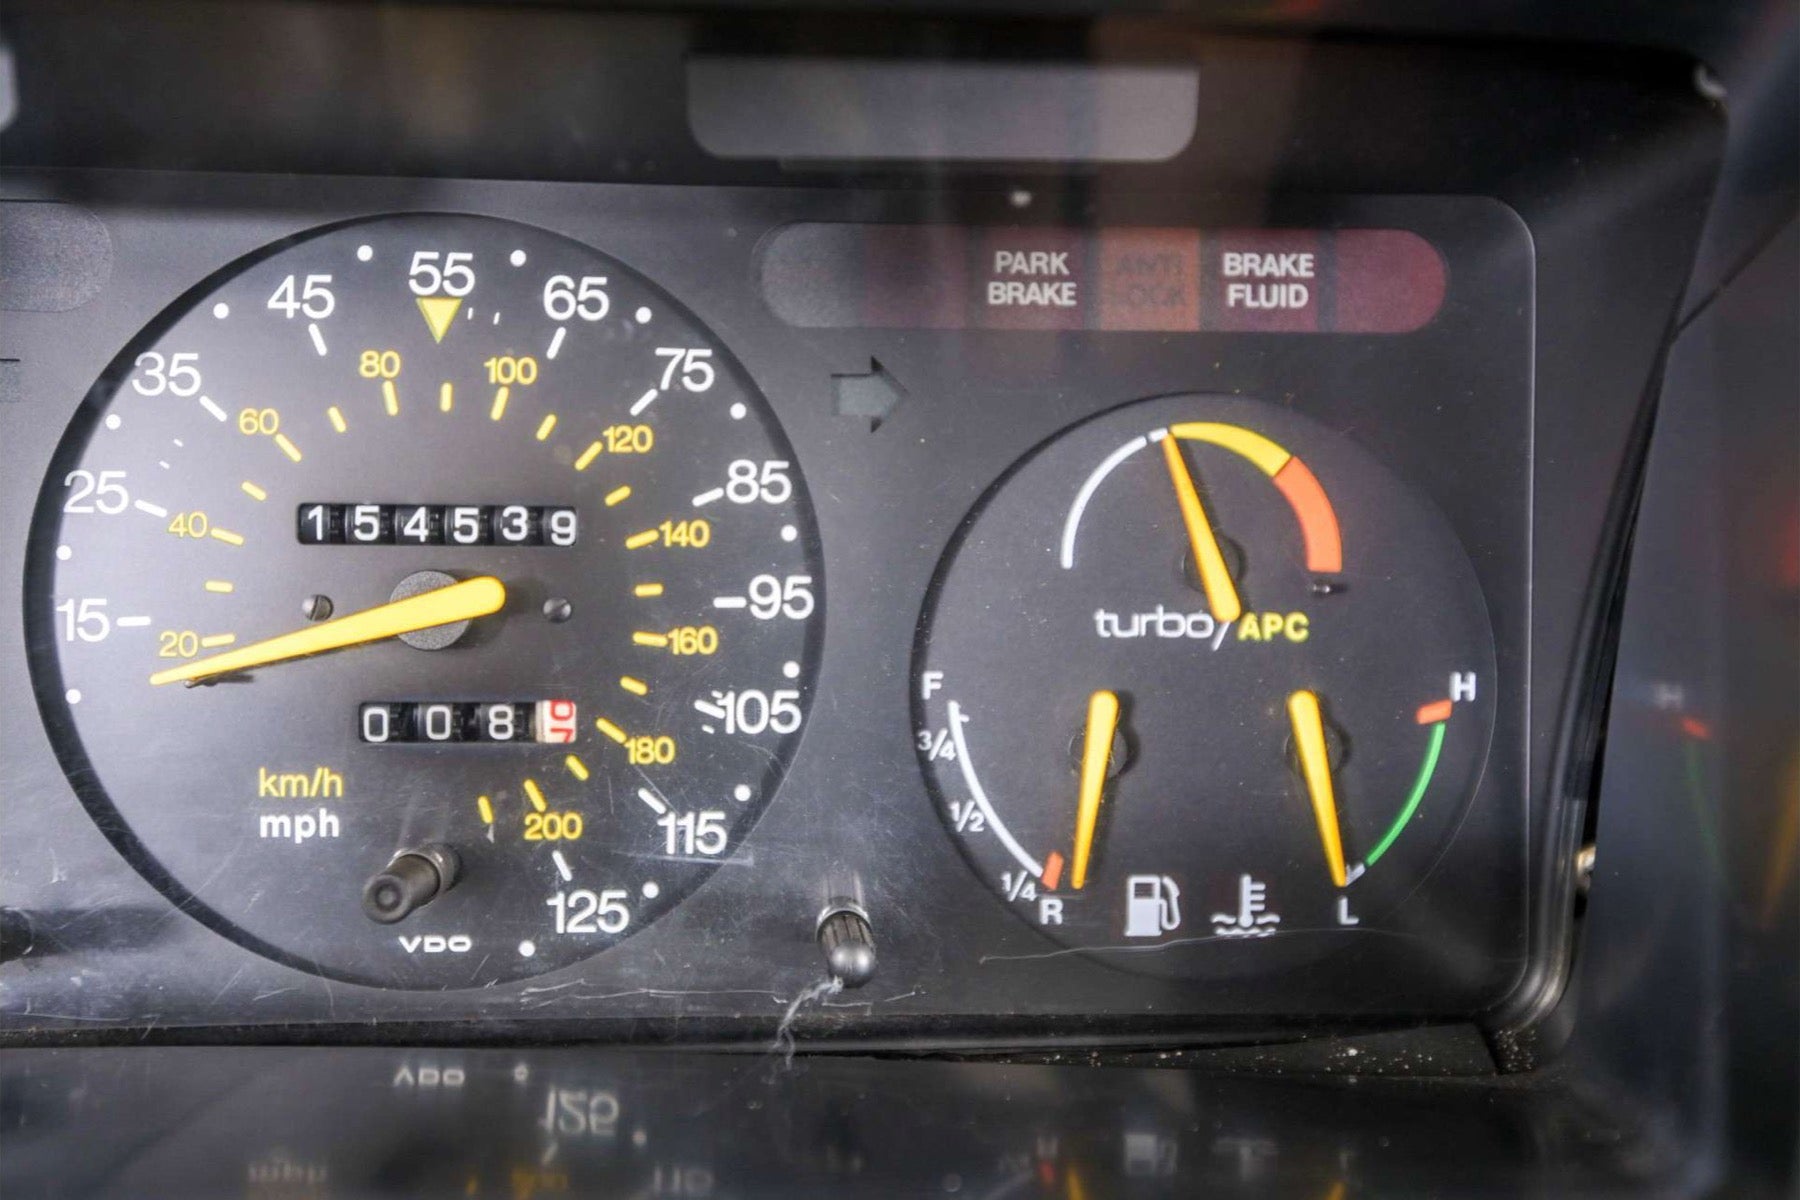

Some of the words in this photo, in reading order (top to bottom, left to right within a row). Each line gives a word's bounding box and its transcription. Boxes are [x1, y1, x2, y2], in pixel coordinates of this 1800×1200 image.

[408, 251, 476, 297] 55
[995, 250, 1071, 276] PARK
[1222, 252, 1315, 279] BRAKE
[267, 274, 336, 320] 45
[543, 274, 610, 321] 65
[987, 281, 1078, 307] BRAKE
[1227, 283, 1310, 310] FLUID
[131, 351, 202, 397] 35
[358, 350, 402, 379] 80
[484, 356, 538, 386] 100
[655, 347, 715, 393] 75
[238, 407, 280, 436] 60
[603, 425, 654, 454] 120
[63, 470, 130, 515] 25
[725, 459, 792, 505] 85
[168, 511, 208, 539] 40
[308, 504, 577, 546] 154539
[659, 519, 710, 548] 140
[748, 574, 815, 620] 95
[57, 597, 111, 643] 15
[159, 630, 199, 658] 20
[667, 626, 718, 656] 160
[922, 671, 944, 701] F
[1449, 671, 1477, 702] H
[721, 689, 802, 736] 105
[624, 736, 675, 765] 180
[917, 728, 957, 762] 3/4
[258, 766, 343, 798] km/h
[259, 807, 340, 844] mph
[524, 812, 583, 841] 200
[949, 800, 985, 833] 1/2
[656, 812, 727, 855] 115
[1001, 869, 1038, 902] 1/4
[546, 890, 630, 935] 125
[1040, 897, 1064, 925] R
[1338, 897, 1360, 925] L
[398, 935, 472, 954] VDO
